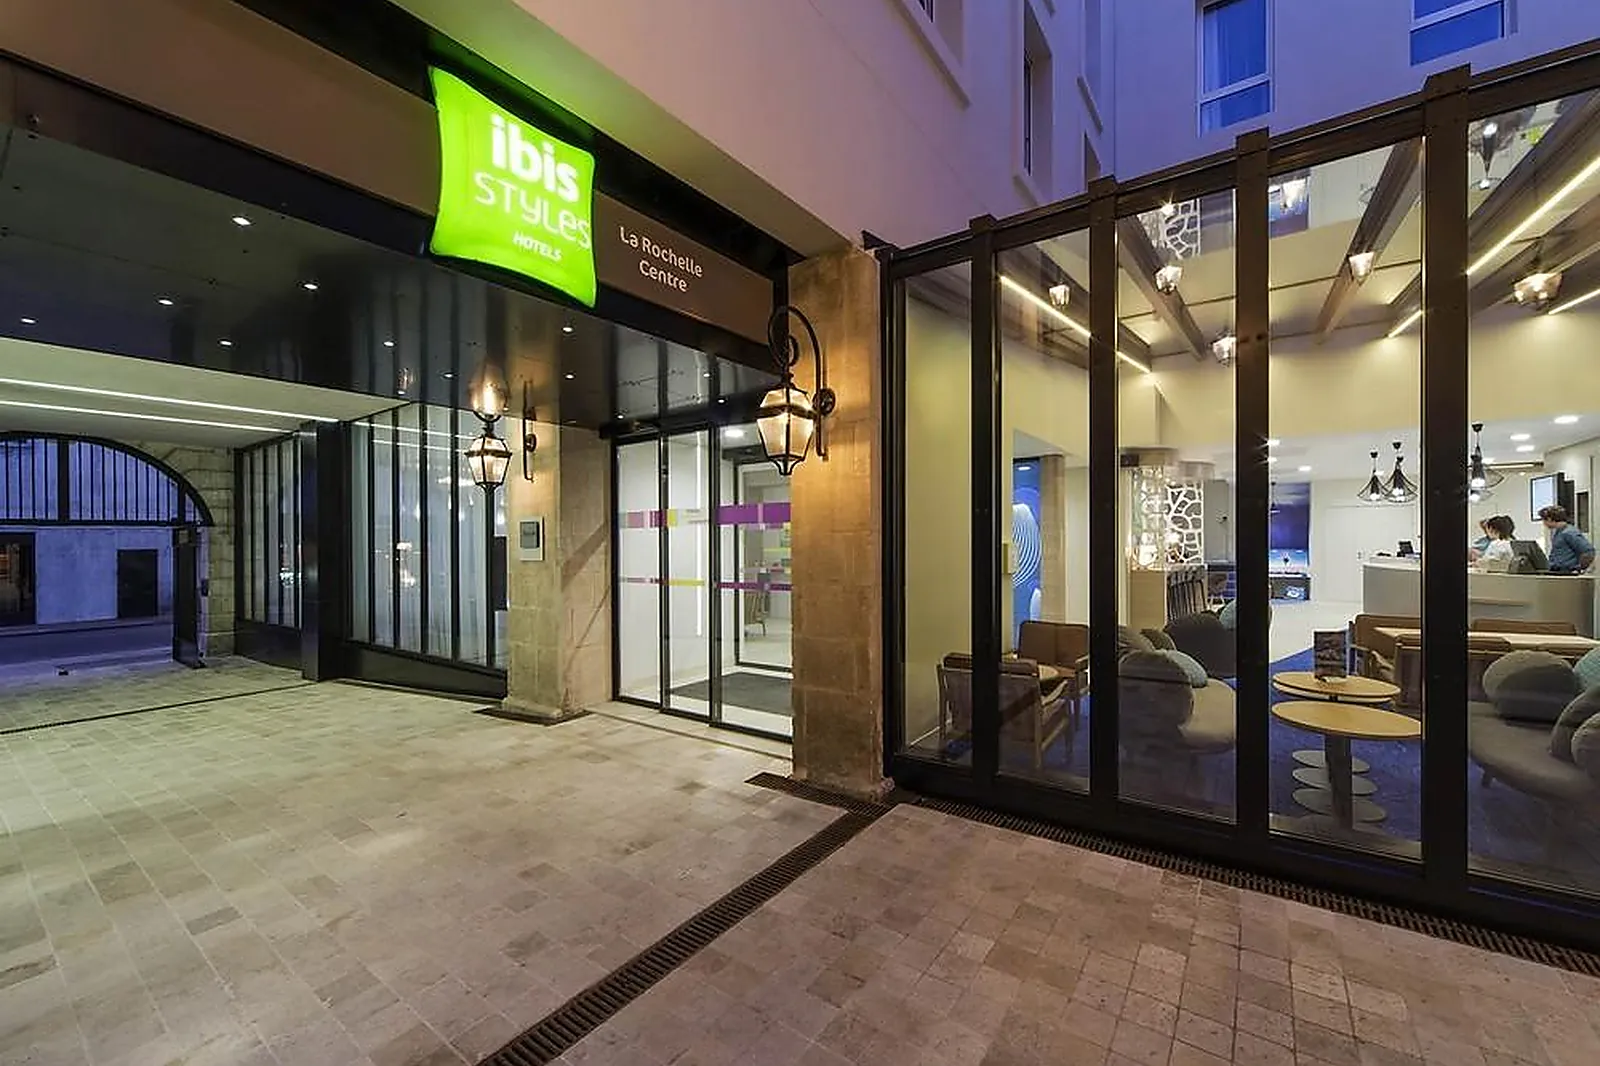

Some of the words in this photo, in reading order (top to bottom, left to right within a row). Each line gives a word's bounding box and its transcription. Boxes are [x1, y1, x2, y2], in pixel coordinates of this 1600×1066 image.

[491, 114, 580, 202] ibis
[512, 231, 562, 262] HOTELS
[620, 226, 639, 248] La
[642, 237, 703, 279] Rochelle
[639, 259, 688, 293] Centre
